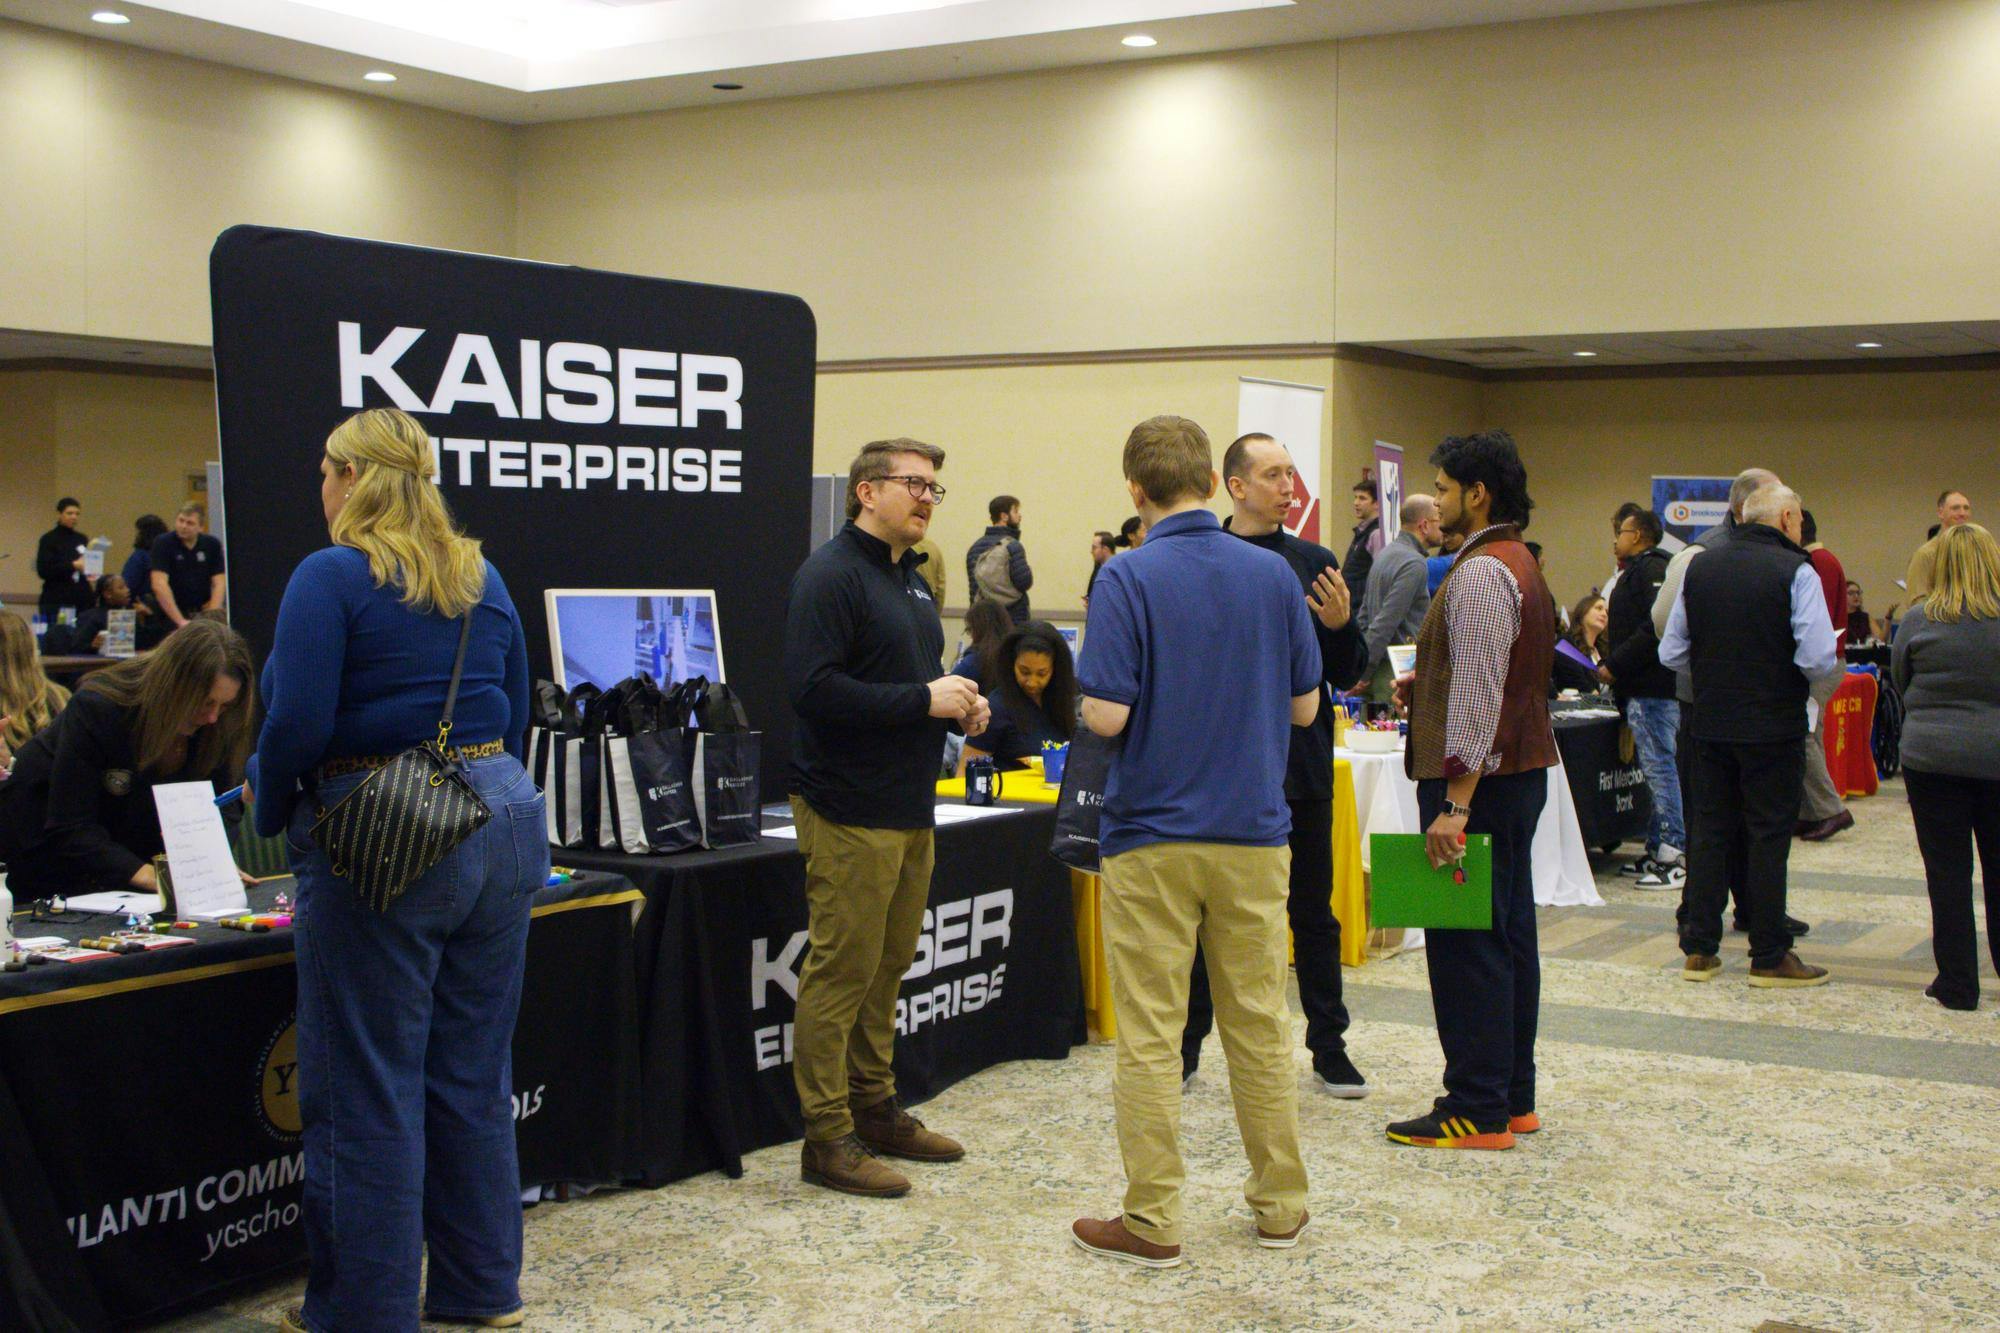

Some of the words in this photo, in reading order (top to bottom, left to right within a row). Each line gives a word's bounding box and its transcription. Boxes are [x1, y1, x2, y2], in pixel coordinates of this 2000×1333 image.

[338, 321, 744, 430] KAISER
[429, 435, 743, 494] TERPRISE
[751, 887, 1014, 1011] KSER
[754, 962, 1007, 1072] ERPRISE
[195, 1151, 305, 1212] COMM
[200, 1200, 304, 1262] ycscho
